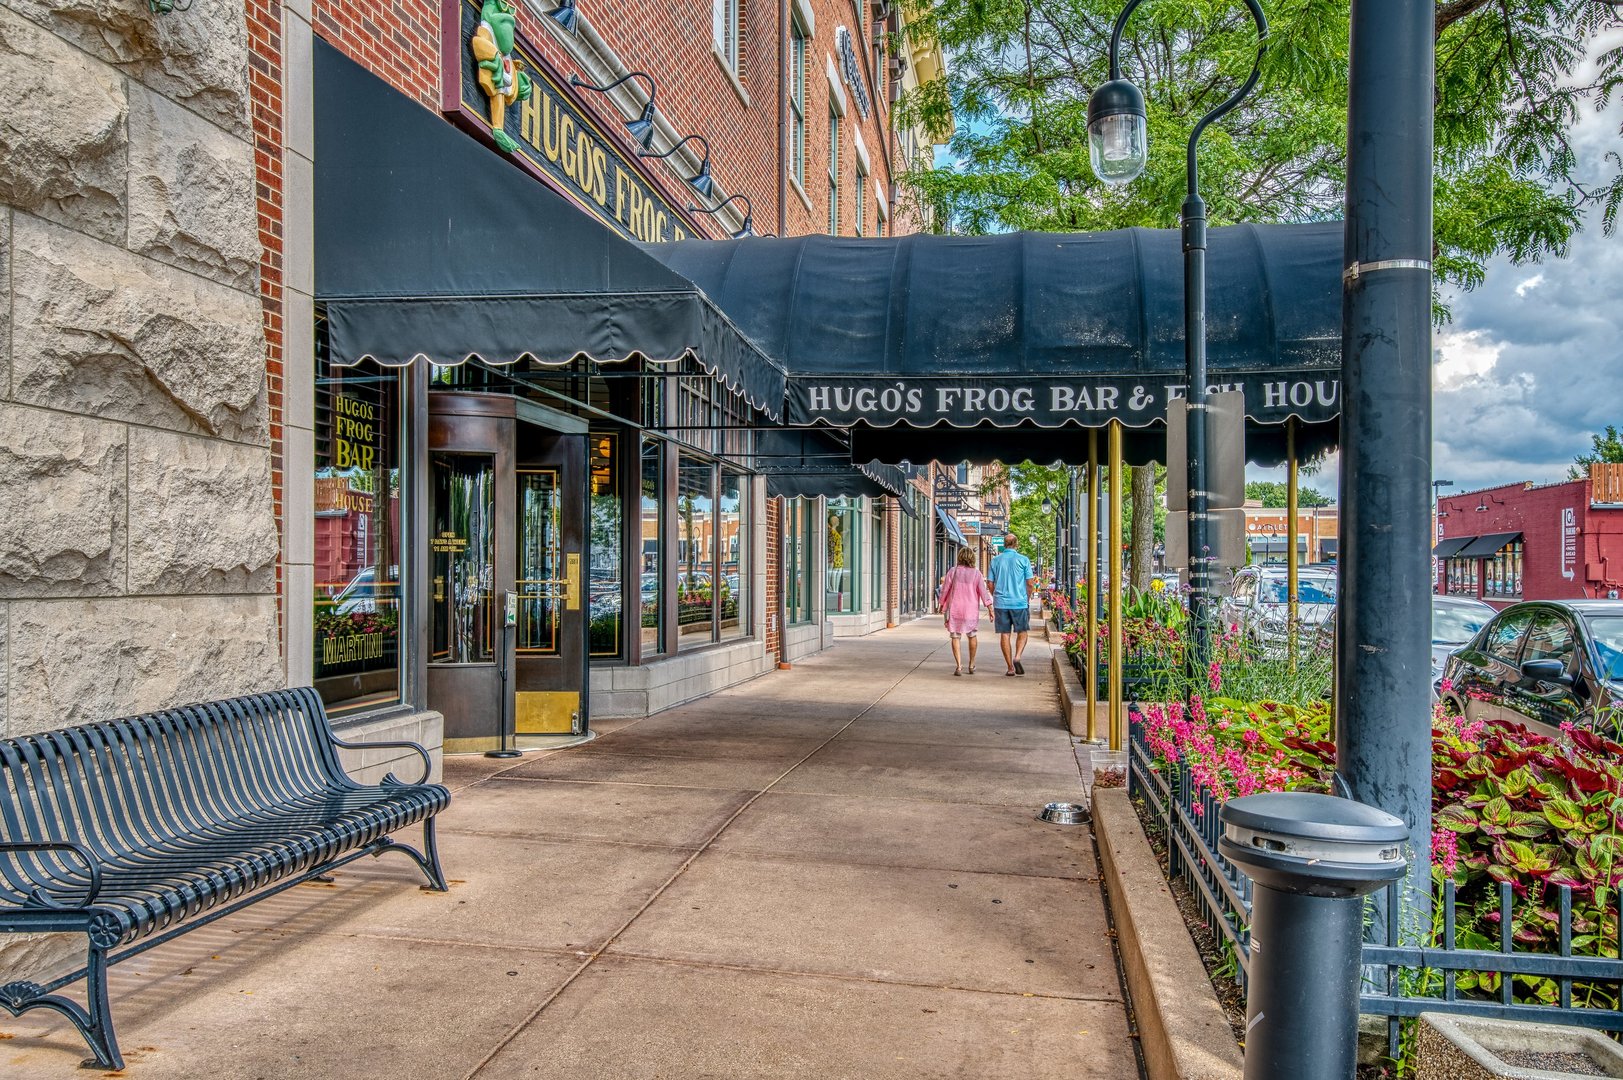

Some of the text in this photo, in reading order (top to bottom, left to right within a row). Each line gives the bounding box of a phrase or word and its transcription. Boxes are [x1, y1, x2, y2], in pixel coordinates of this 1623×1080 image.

[520, 81, 607, 206] HUGO'S
[336, 395, 374, 420] HUGO'S
[808, 382, 922, 412] HUGO'S
[935, 387, 1035, 412] FROG
[1049, 386, 1120, 411] BAR
[1128, 385, 1154, 411] &
[336, 415, 374, 442] FROG
[336, 437, 374, 471] BAR
[336, 493, 374, 513] HOUSE
[323, 632, 383, 665] MARTINI
